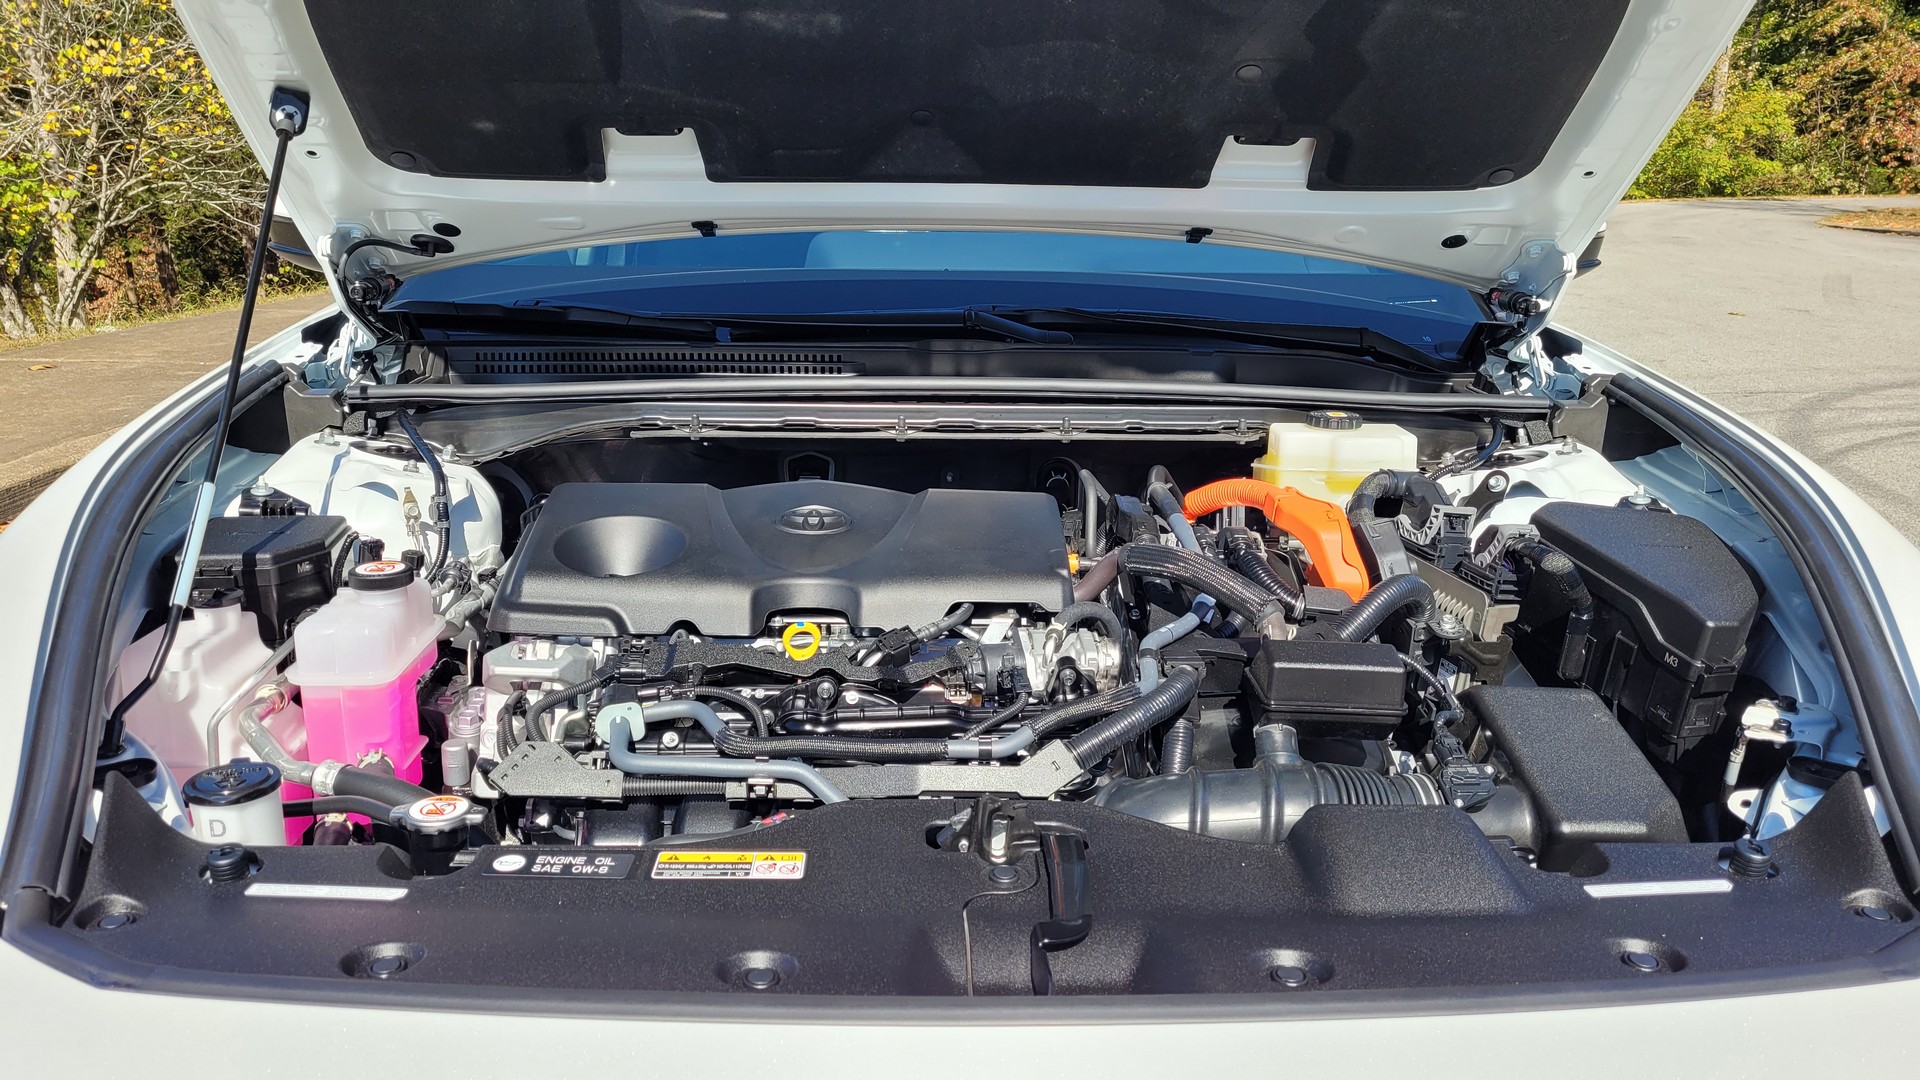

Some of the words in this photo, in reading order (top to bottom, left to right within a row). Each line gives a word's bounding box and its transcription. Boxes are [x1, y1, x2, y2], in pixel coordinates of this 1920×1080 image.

[1664, 652, 1679, 667] M3
[209, 819, 227, 838] D
[536, 855, 586, 864] ENGINE
[594, 857, 616, 865] OIL
[531, 865, 562, 873] SAE
